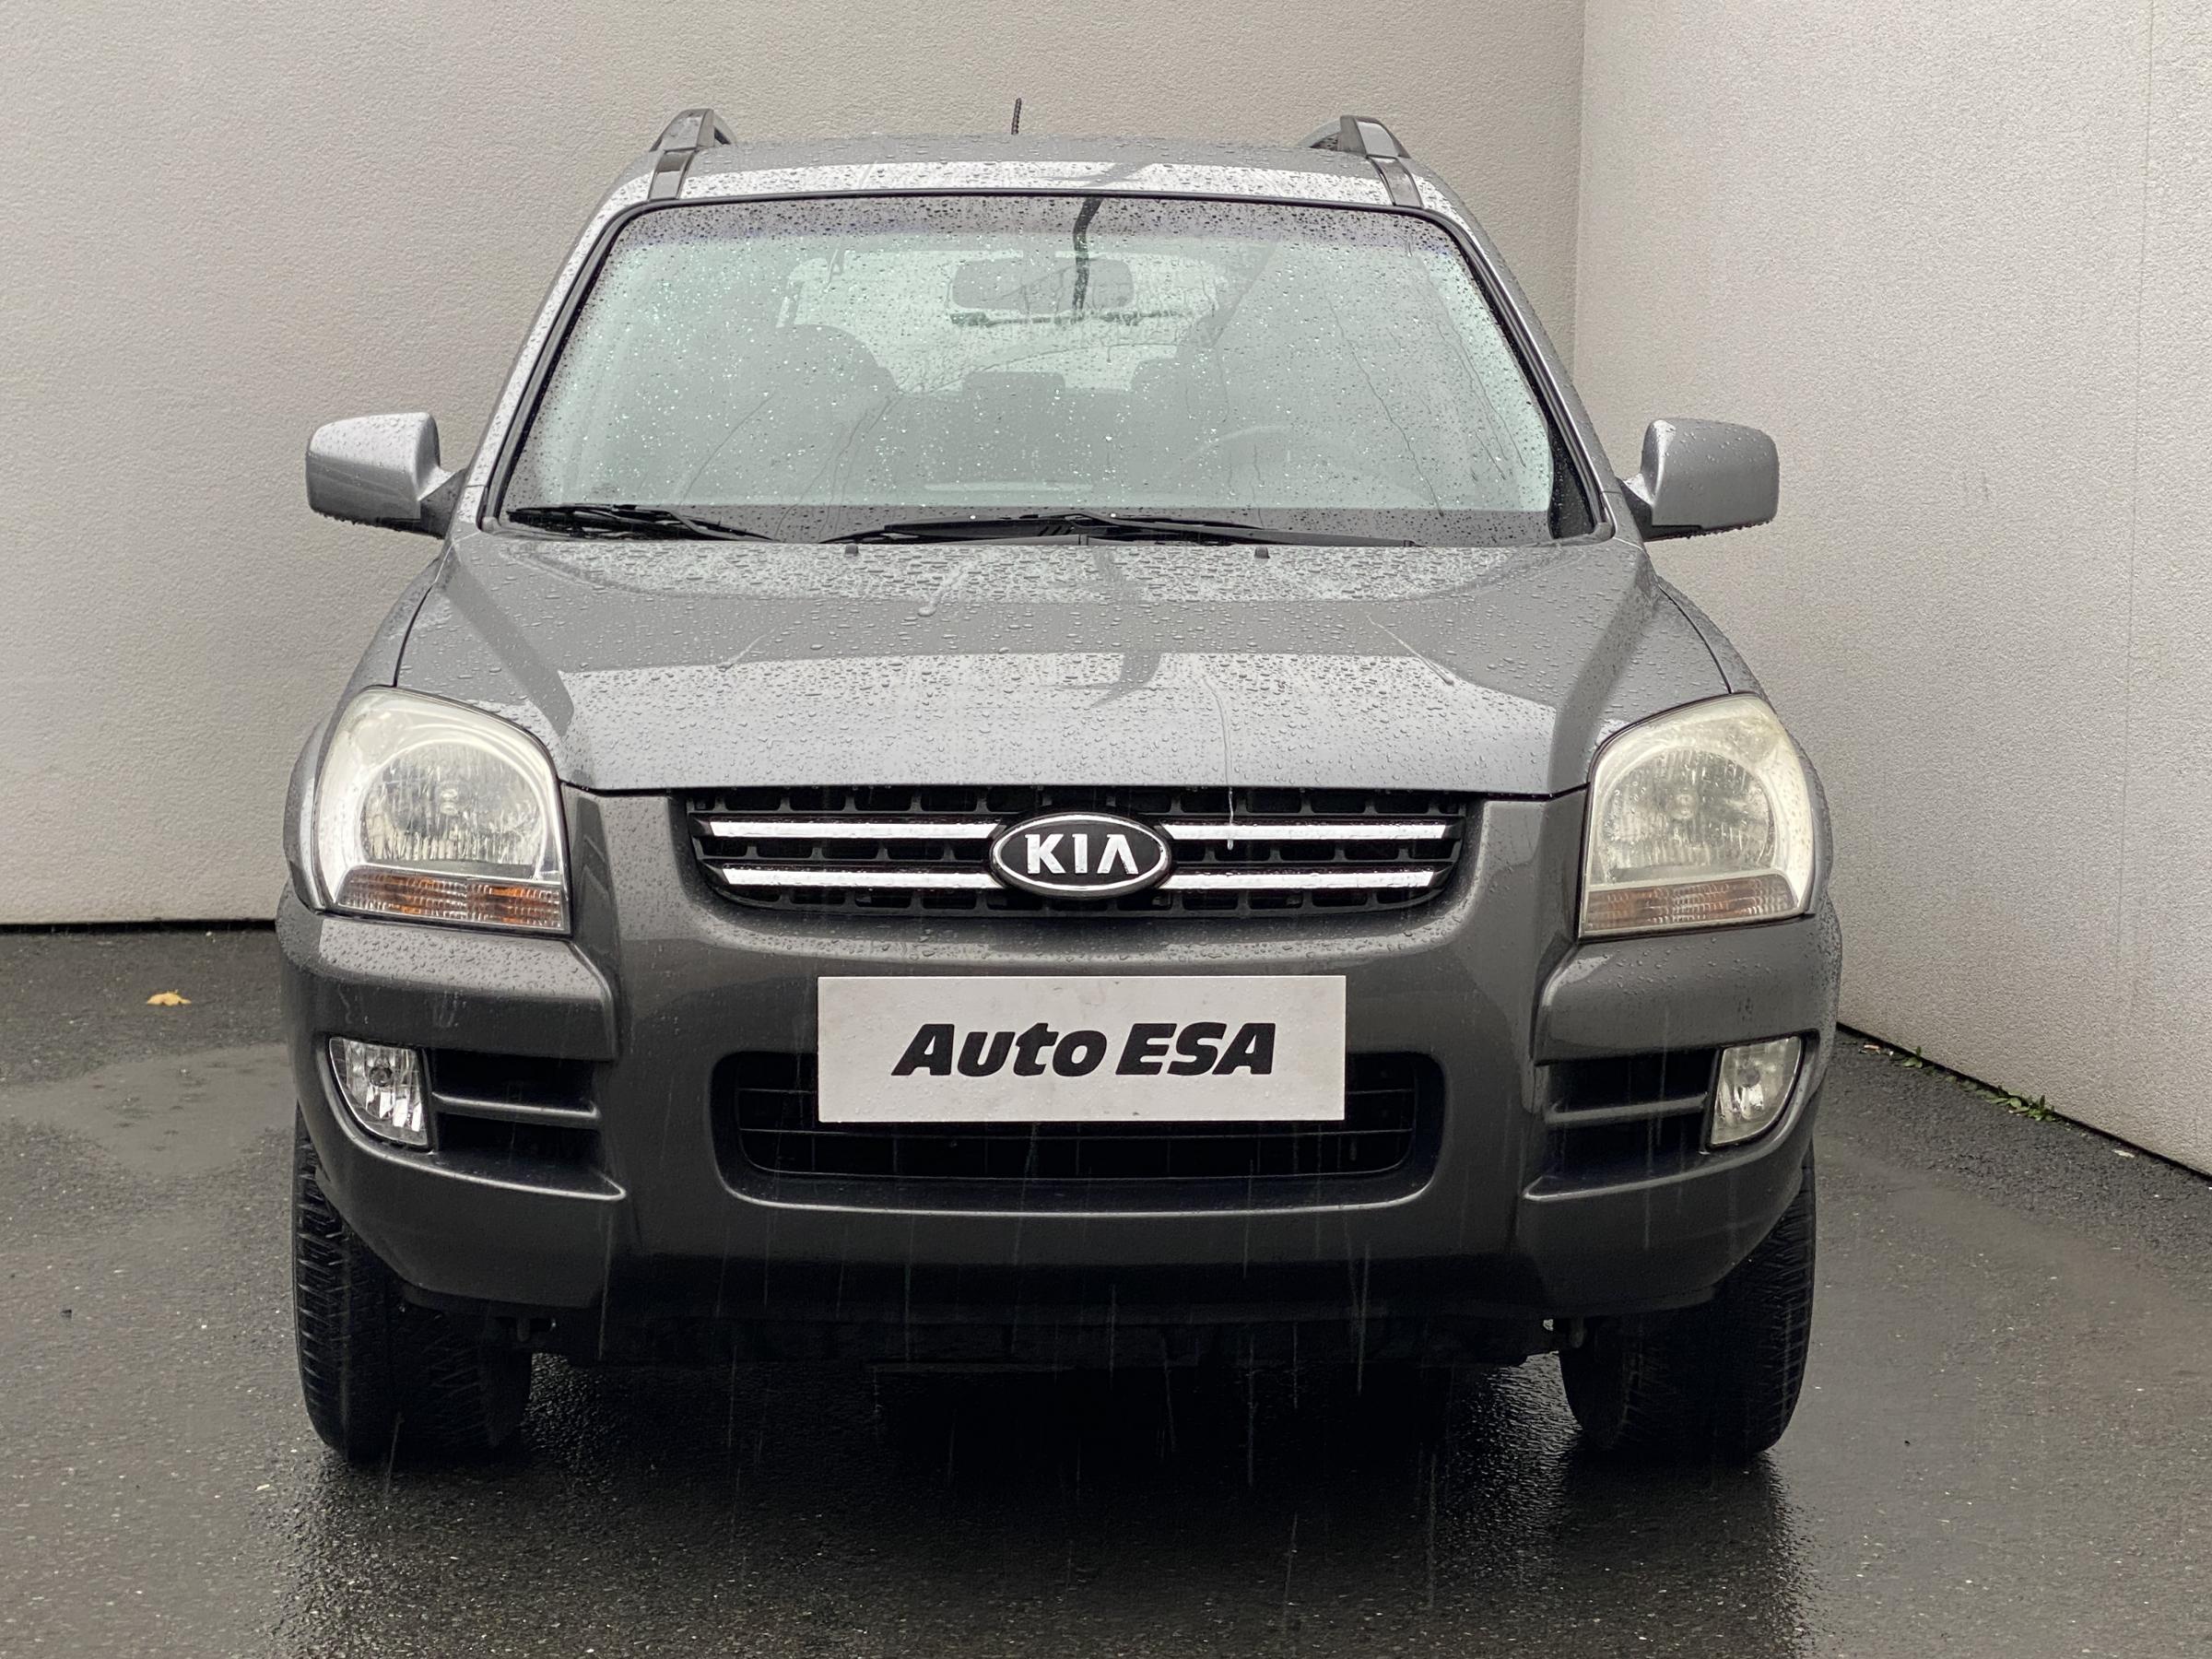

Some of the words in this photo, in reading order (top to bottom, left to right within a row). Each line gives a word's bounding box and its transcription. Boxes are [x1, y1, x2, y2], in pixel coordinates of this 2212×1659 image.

[1024, 833, 1139, 875] KIA
[890, 1022, 1108, 1077] Auto
[1114, 1021, 1277, 1077] ESA
